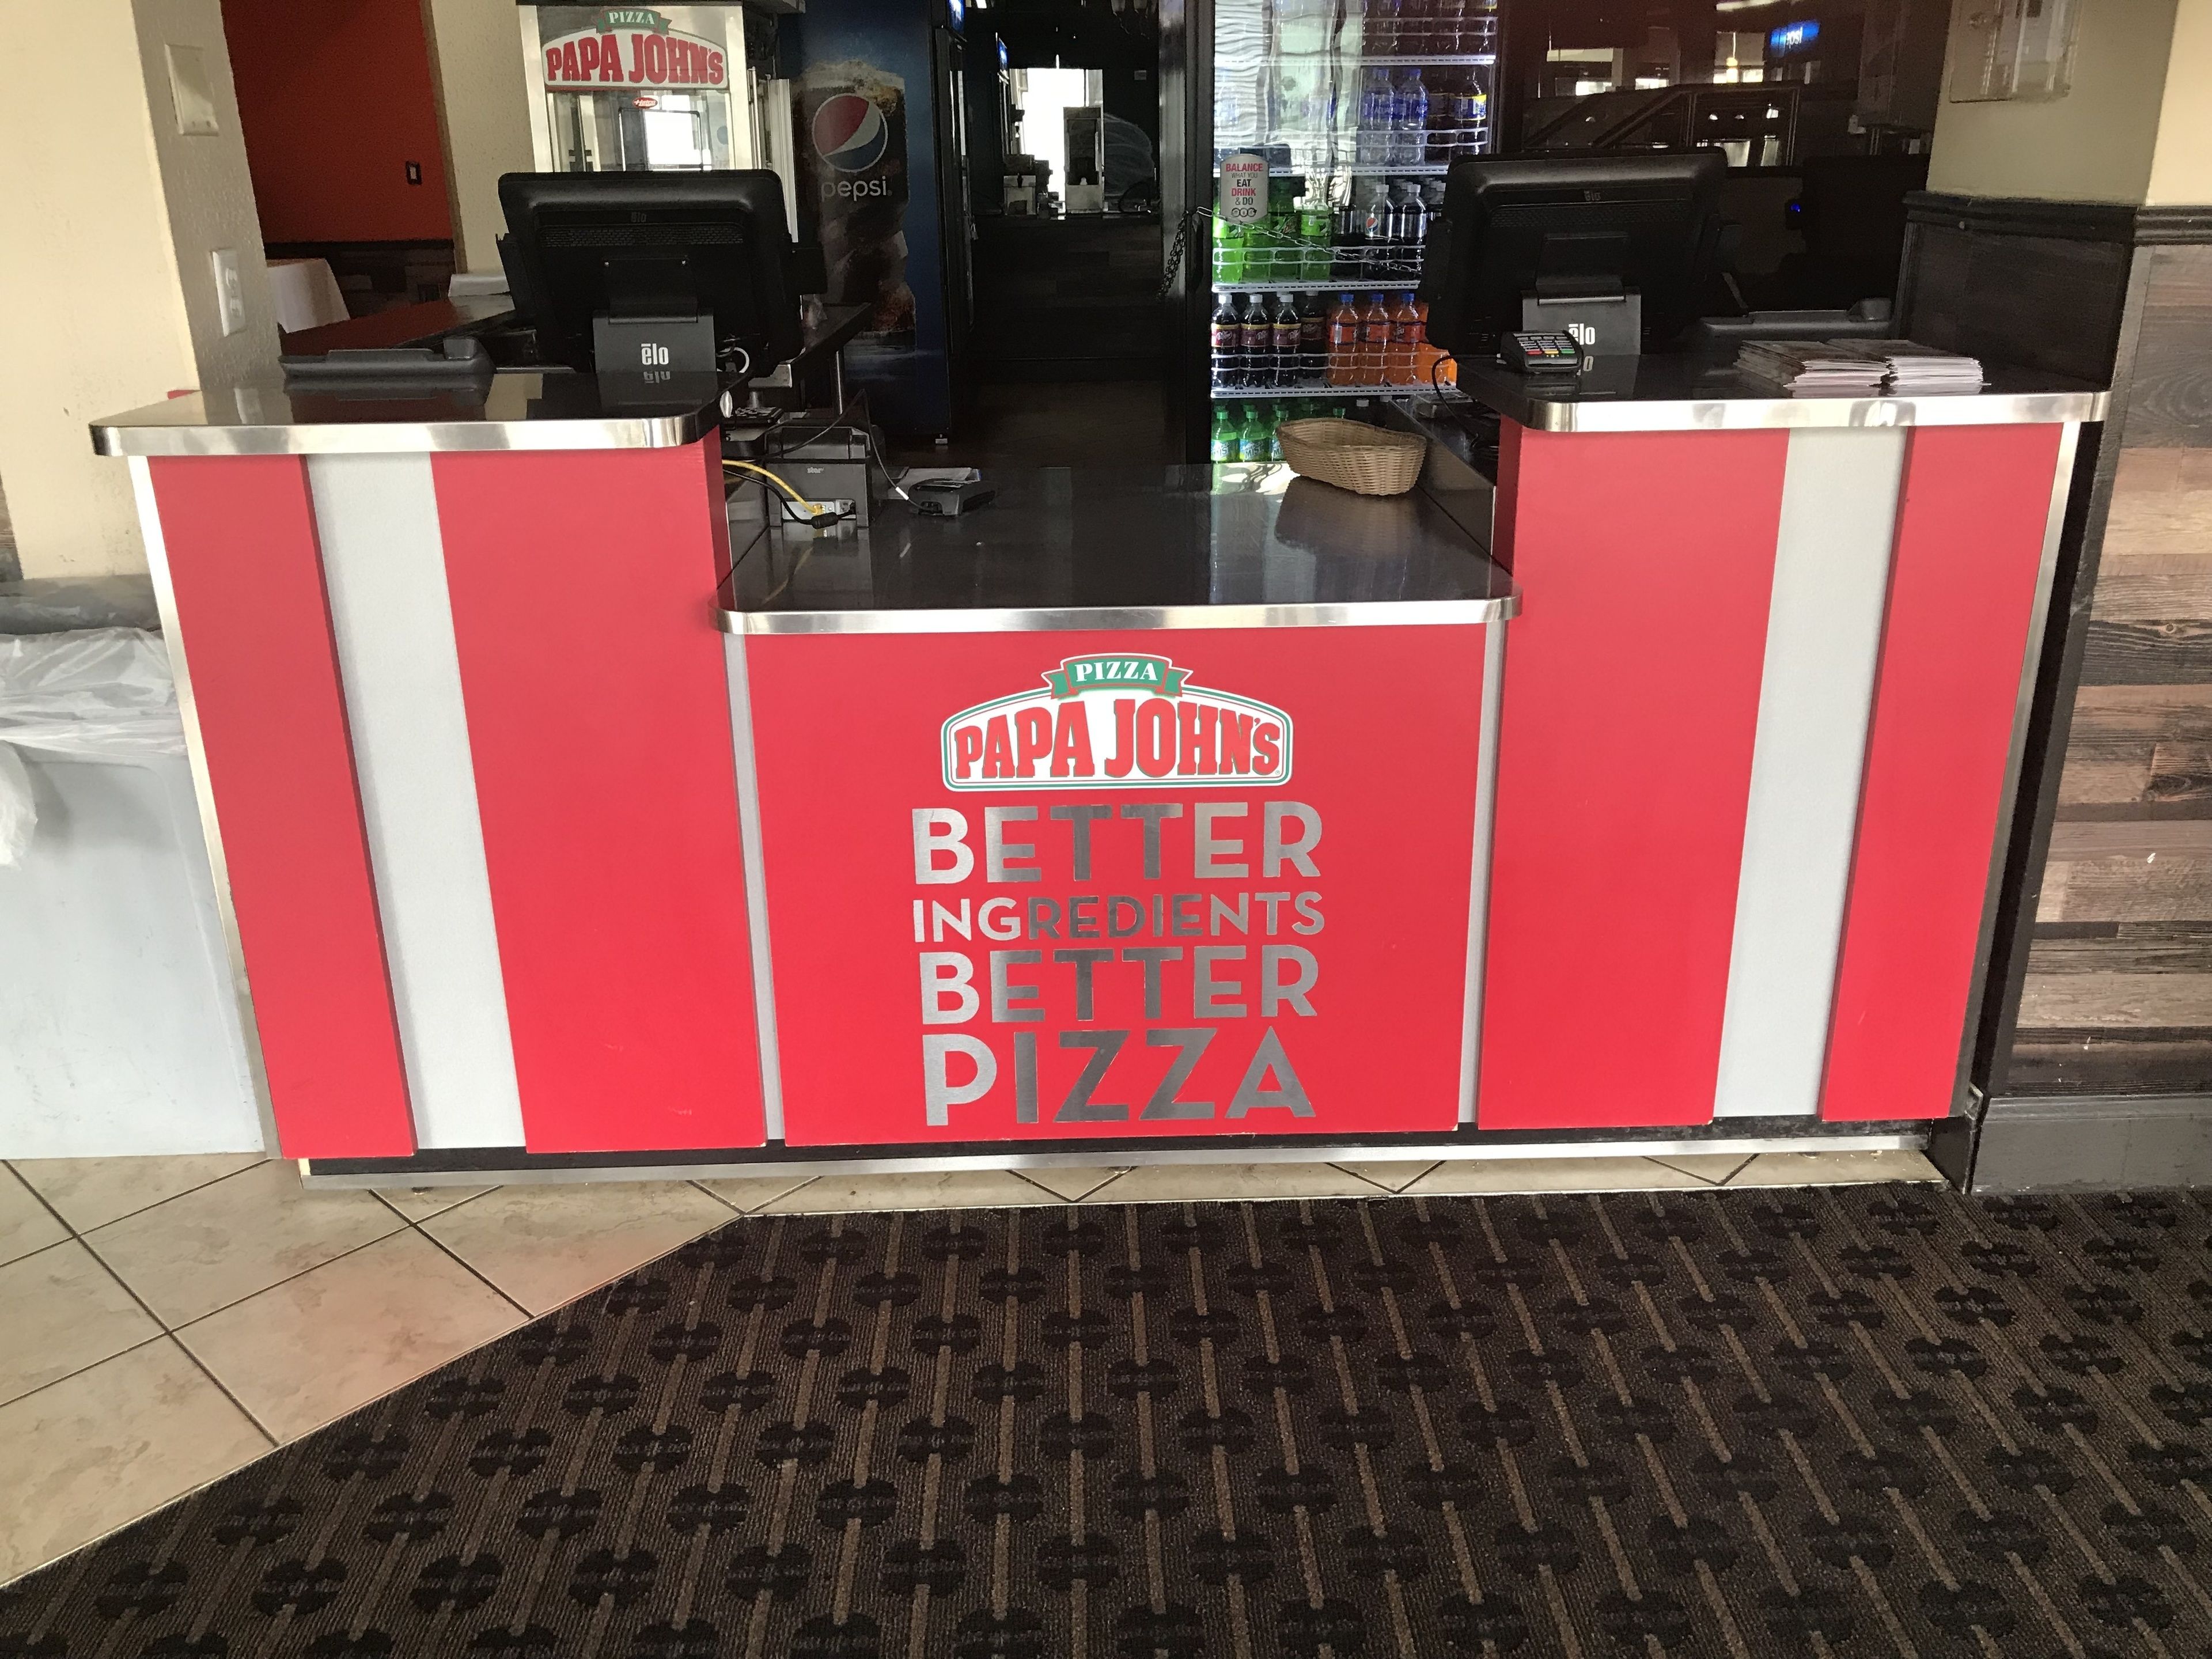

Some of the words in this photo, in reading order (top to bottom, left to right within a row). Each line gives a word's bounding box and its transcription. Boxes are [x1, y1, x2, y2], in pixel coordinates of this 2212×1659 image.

[608, 12, 655, 25] PIZZA
[546, 33, 624, 82] PAPA
[628, 33, 724, 85] JOHN'S
[1225, 163, 1263, 172] BALANCE
[821, 176, 887, 202] pepsi
[1231, 188, 1256, 196] DRINK
[1237, 179, 1252, 187] EAT
[1235, 197, 1241, 206] &
[1243, 197, 1253, 205] DO
[1074, 661, 1158, 682] PIZZA
[955, 700, 1095, 779] PAPA
[1104, 698, 1281, 778] JOHN'S
[911, 801, 1323, 885] BETTER
[913, 891, 1325, 943] INGREDIENTS
[919, 945, 1320, 1025] BETTER
[922, 1025, 1316, 1127] PIZZA
